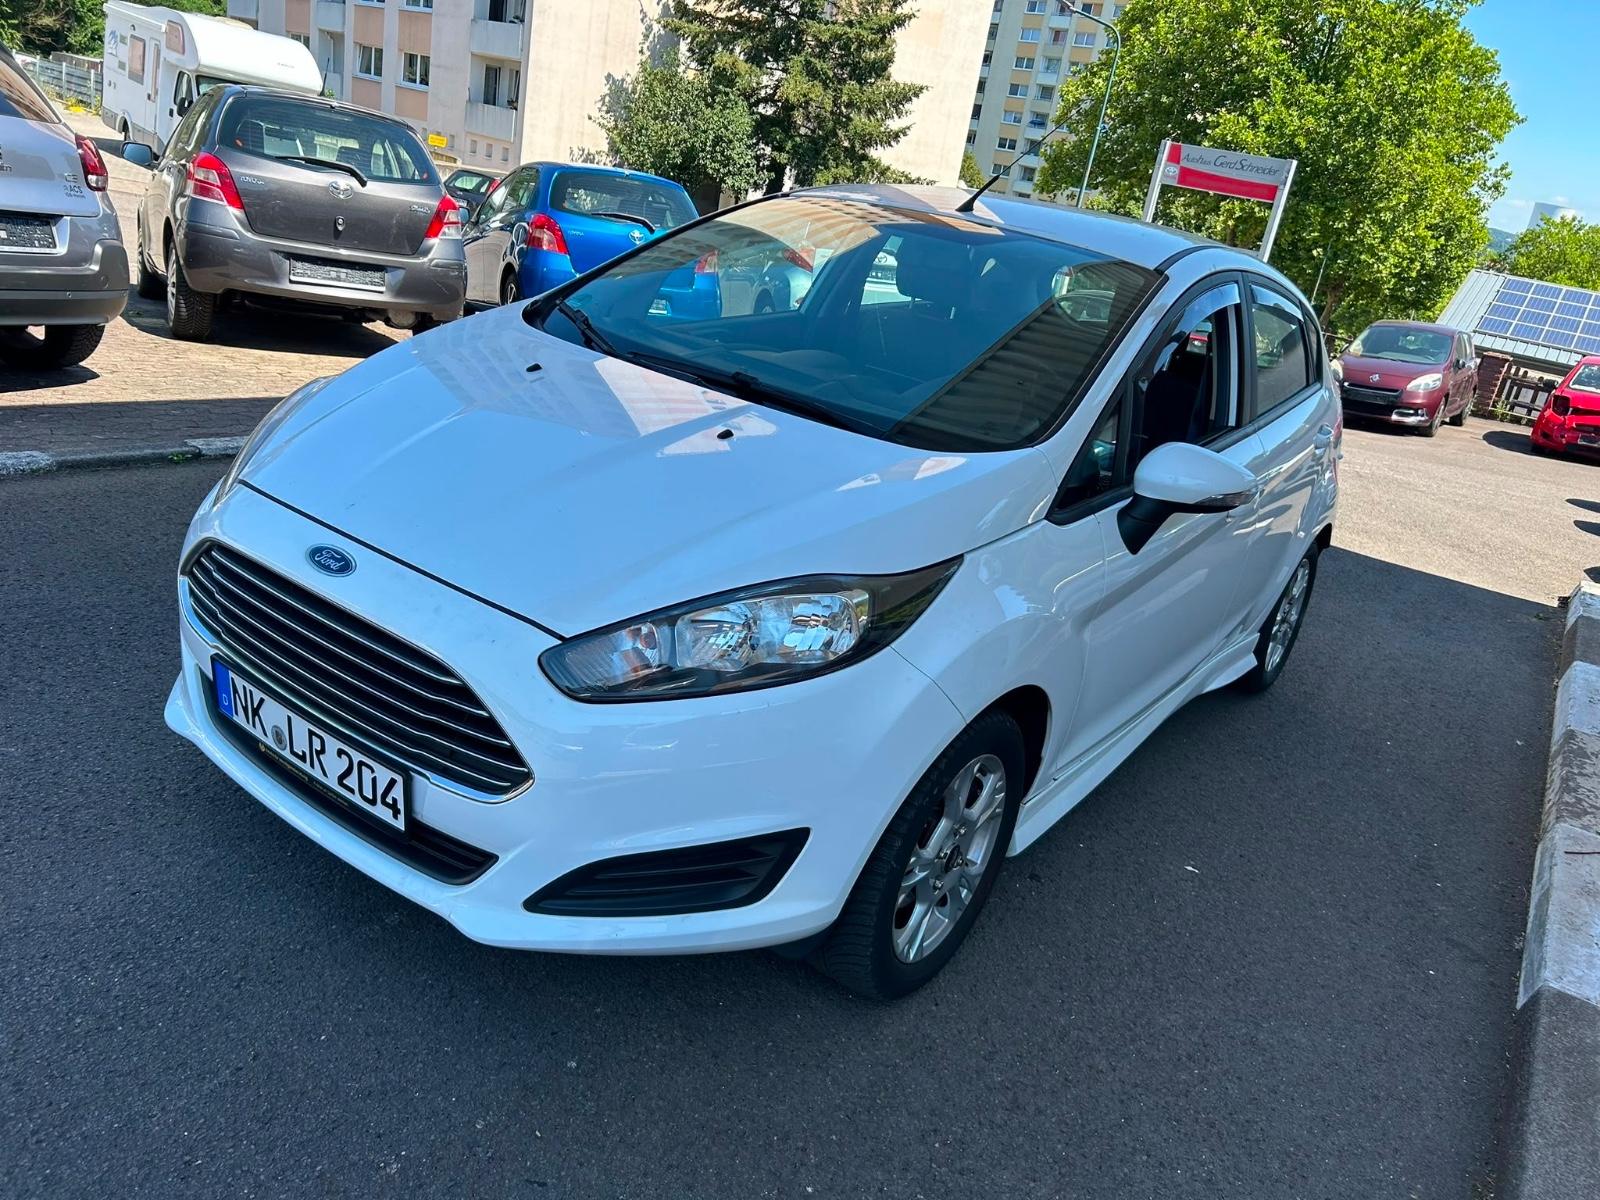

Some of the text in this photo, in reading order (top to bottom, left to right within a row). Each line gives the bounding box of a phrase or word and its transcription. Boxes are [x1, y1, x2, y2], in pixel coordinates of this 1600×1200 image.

[1213, 154, 1238, 170] Gerd
[314, 549, 346, 571] Ford
[230, 676, 269, 739] NK
[286, 714, 329, 780] LR
[336, 747, 402, 821] 204
